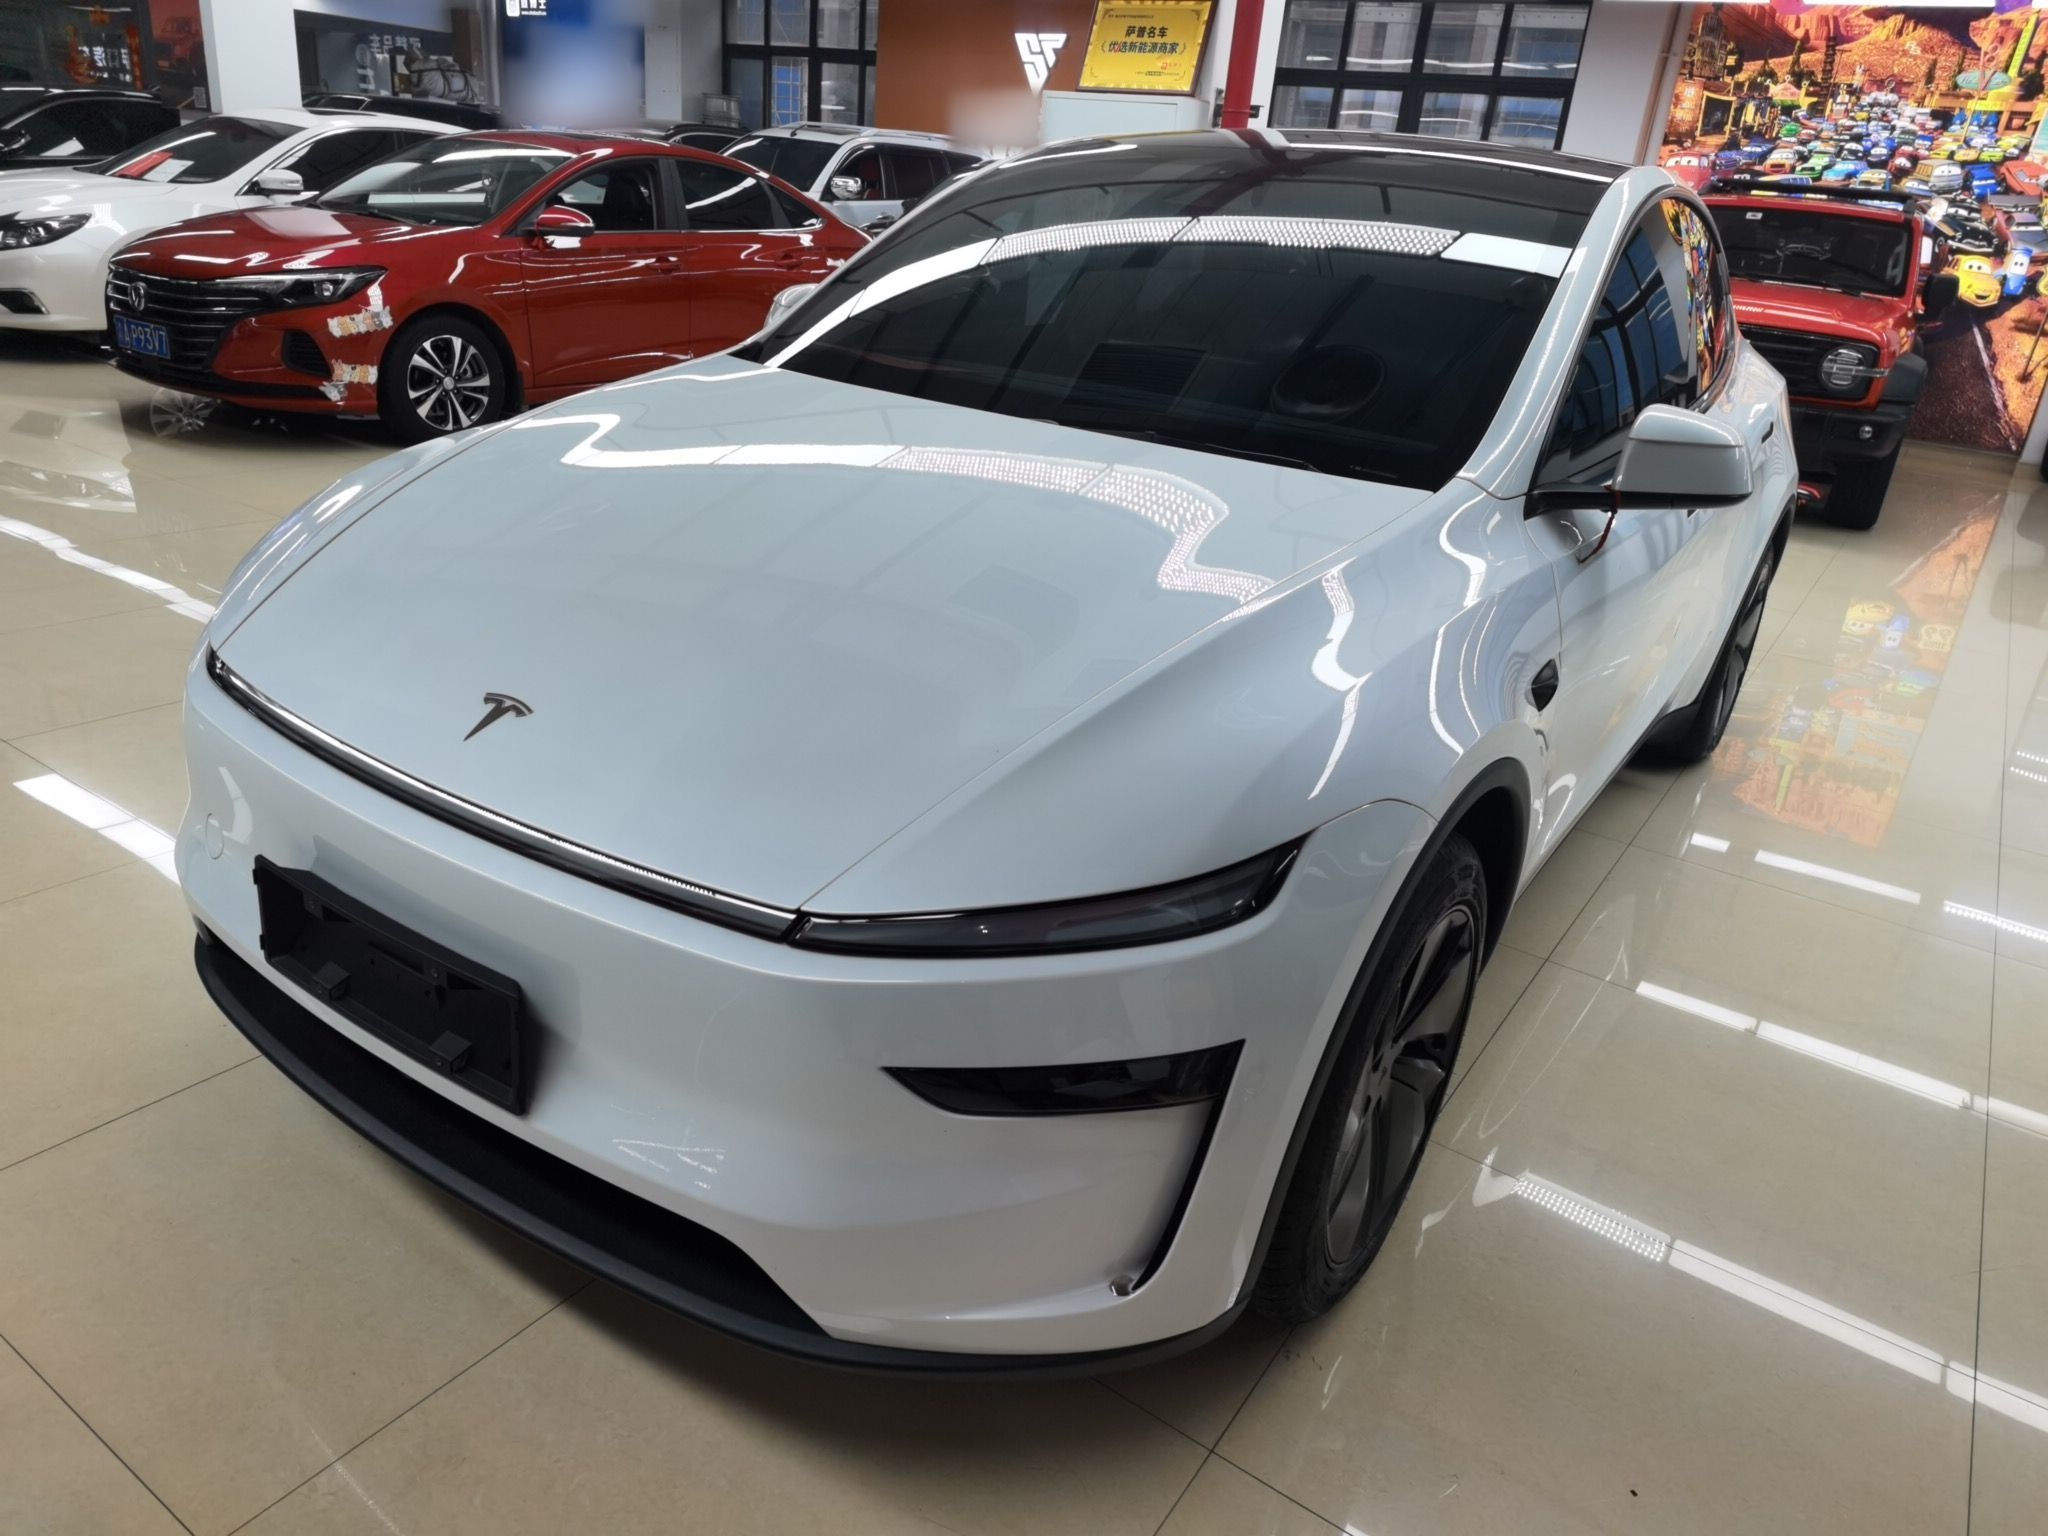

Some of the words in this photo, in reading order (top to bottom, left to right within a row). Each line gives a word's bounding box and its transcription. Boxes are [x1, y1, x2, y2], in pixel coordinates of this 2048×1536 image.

[1125, 25, 1168, 38] 萨普名车
[1108, 41, 1179, 54] 优选新能源商家
